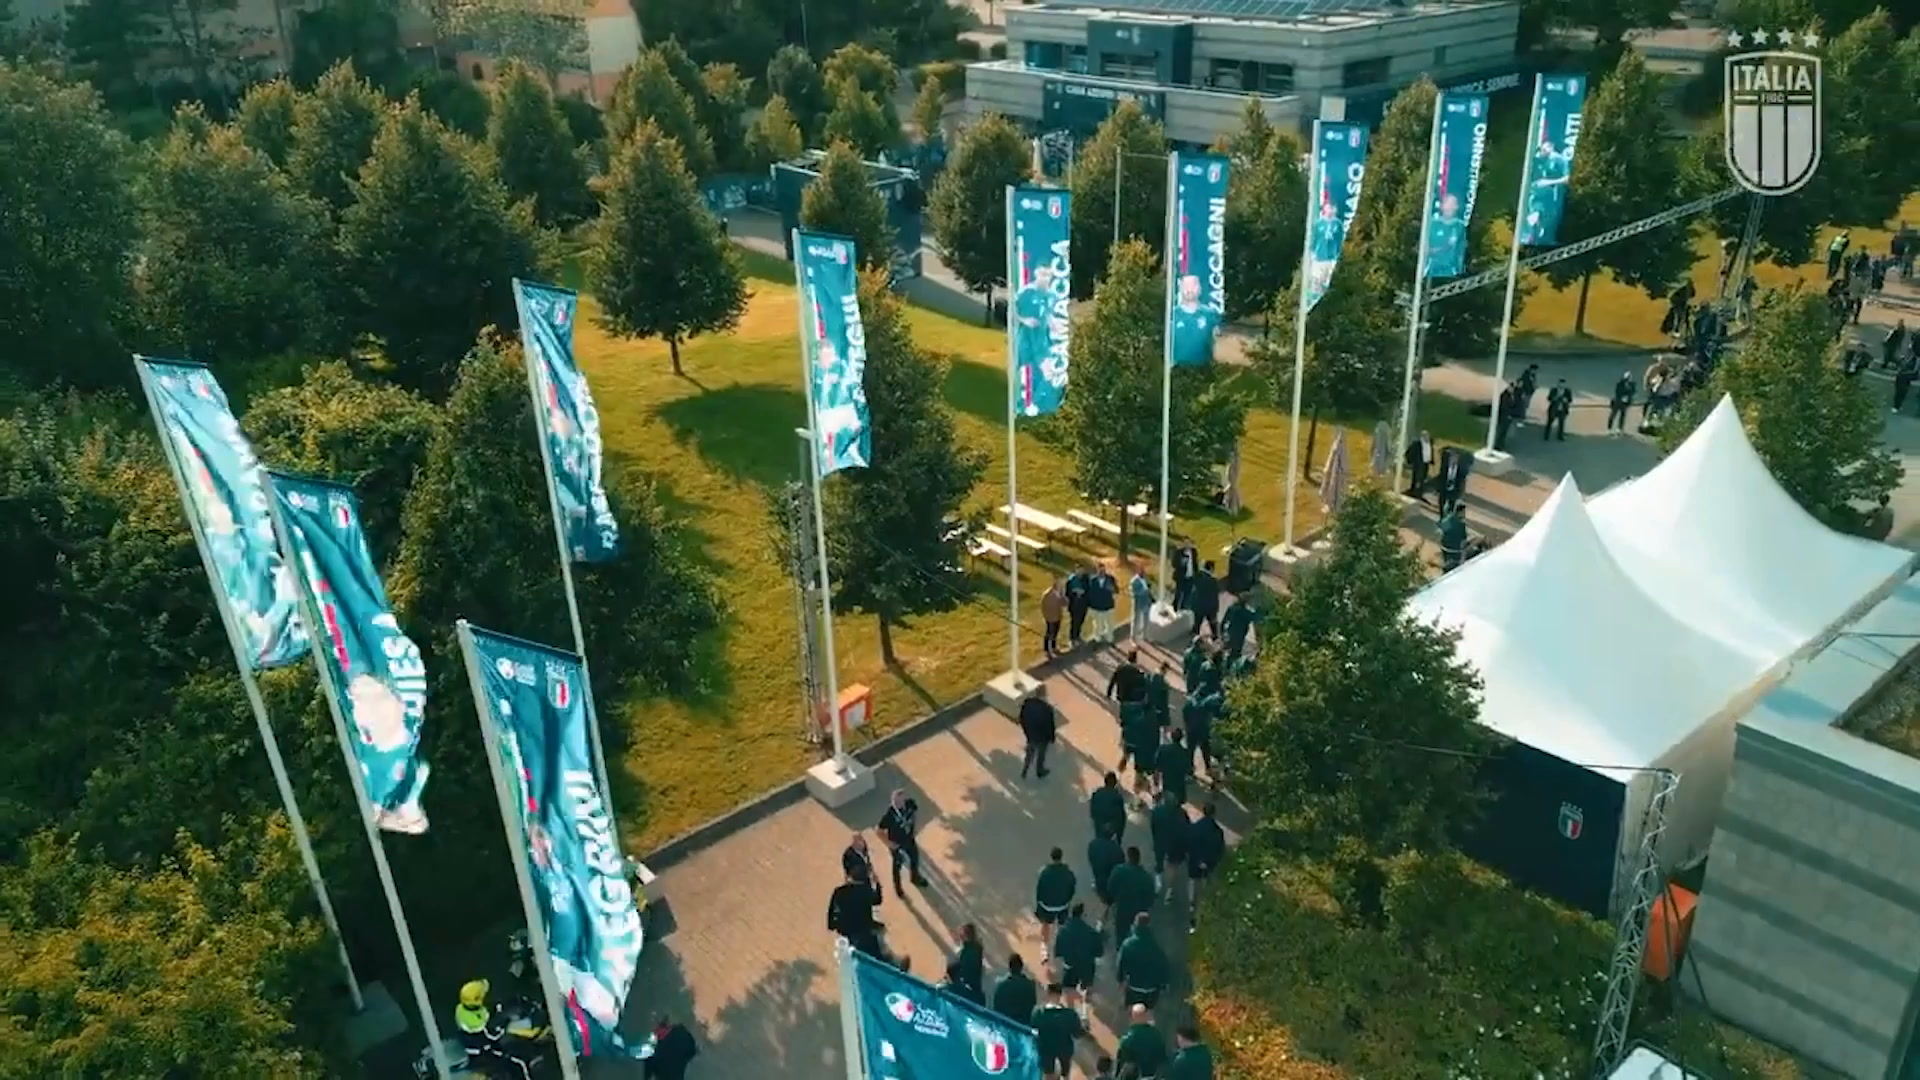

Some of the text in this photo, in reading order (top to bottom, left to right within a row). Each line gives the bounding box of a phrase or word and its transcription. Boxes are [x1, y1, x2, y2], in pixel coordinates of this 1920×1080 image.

[1562, 112, 1582, 161] GATTI
[1051, 238, 1072, 388] SCAMACCA
[1207, 196, 1227, 314] ZACCAGNI
